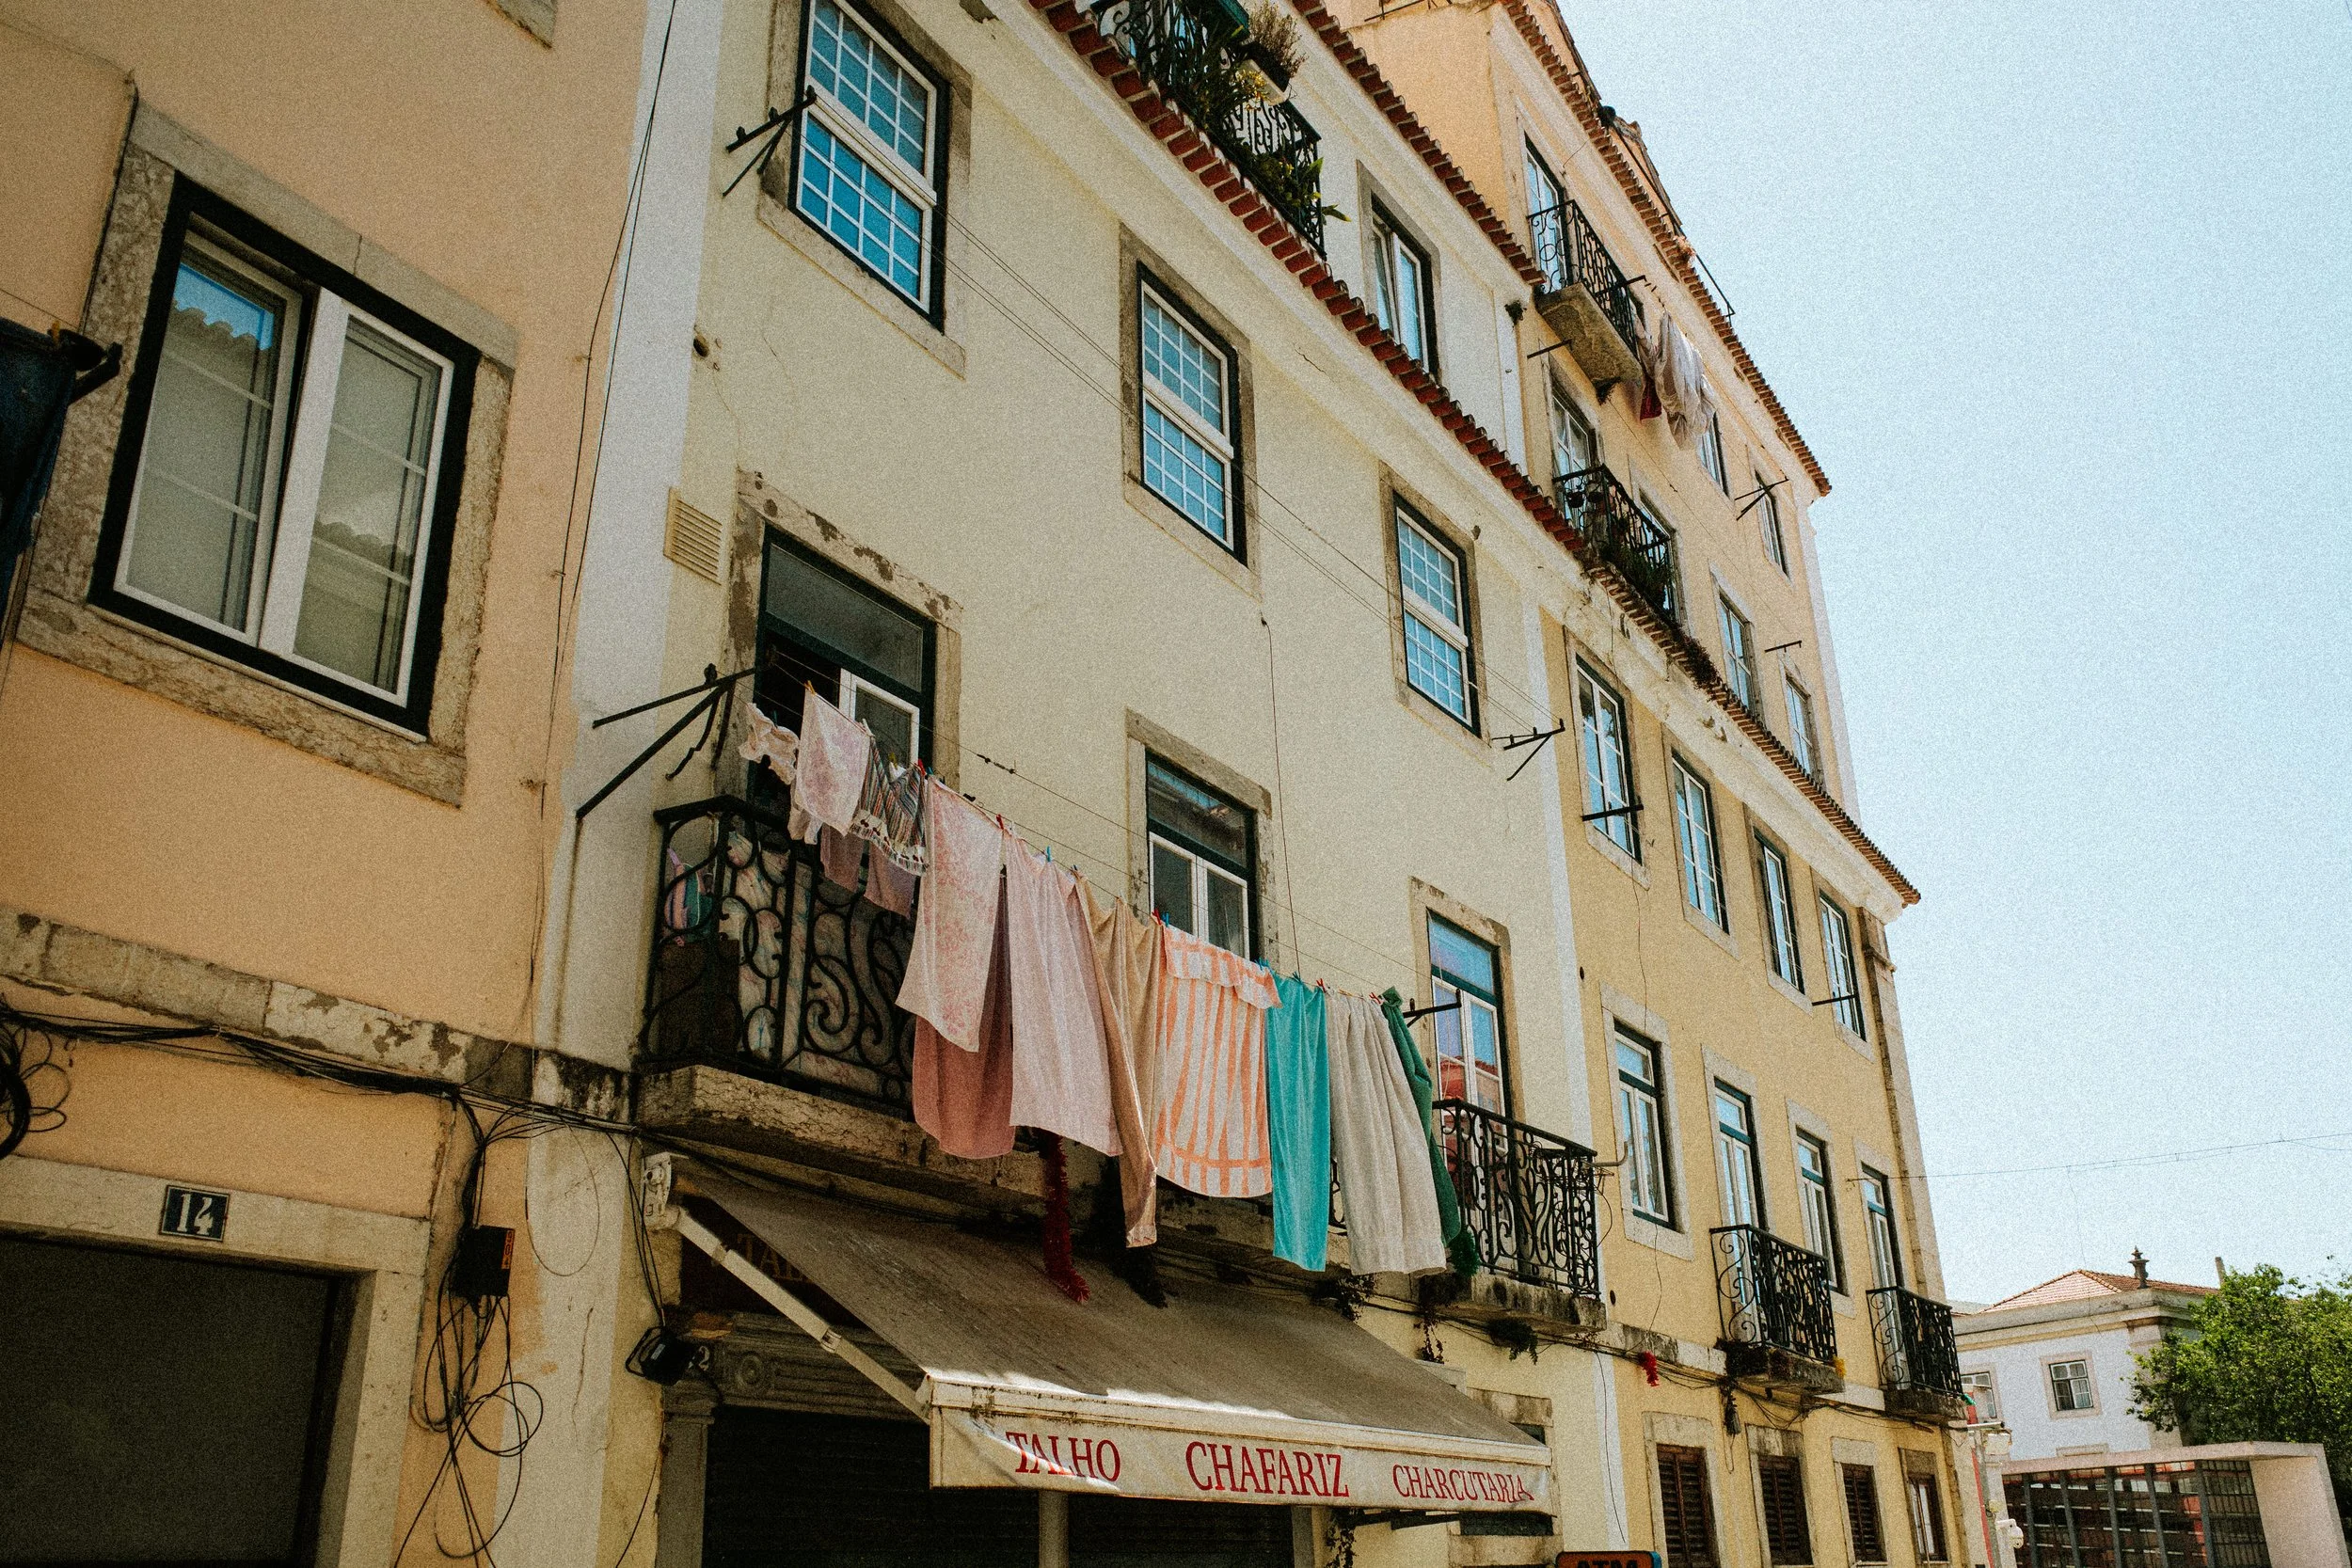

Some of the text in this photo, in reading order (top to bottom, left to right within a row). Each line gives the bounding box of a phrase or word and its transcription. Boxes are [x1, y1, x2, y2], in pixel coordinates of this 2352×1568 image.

[177, 1194, 214, 1235] 14
[1005, 1432, 1534, 1503] TALHO CHAFARIZ CHARCUTARIA
